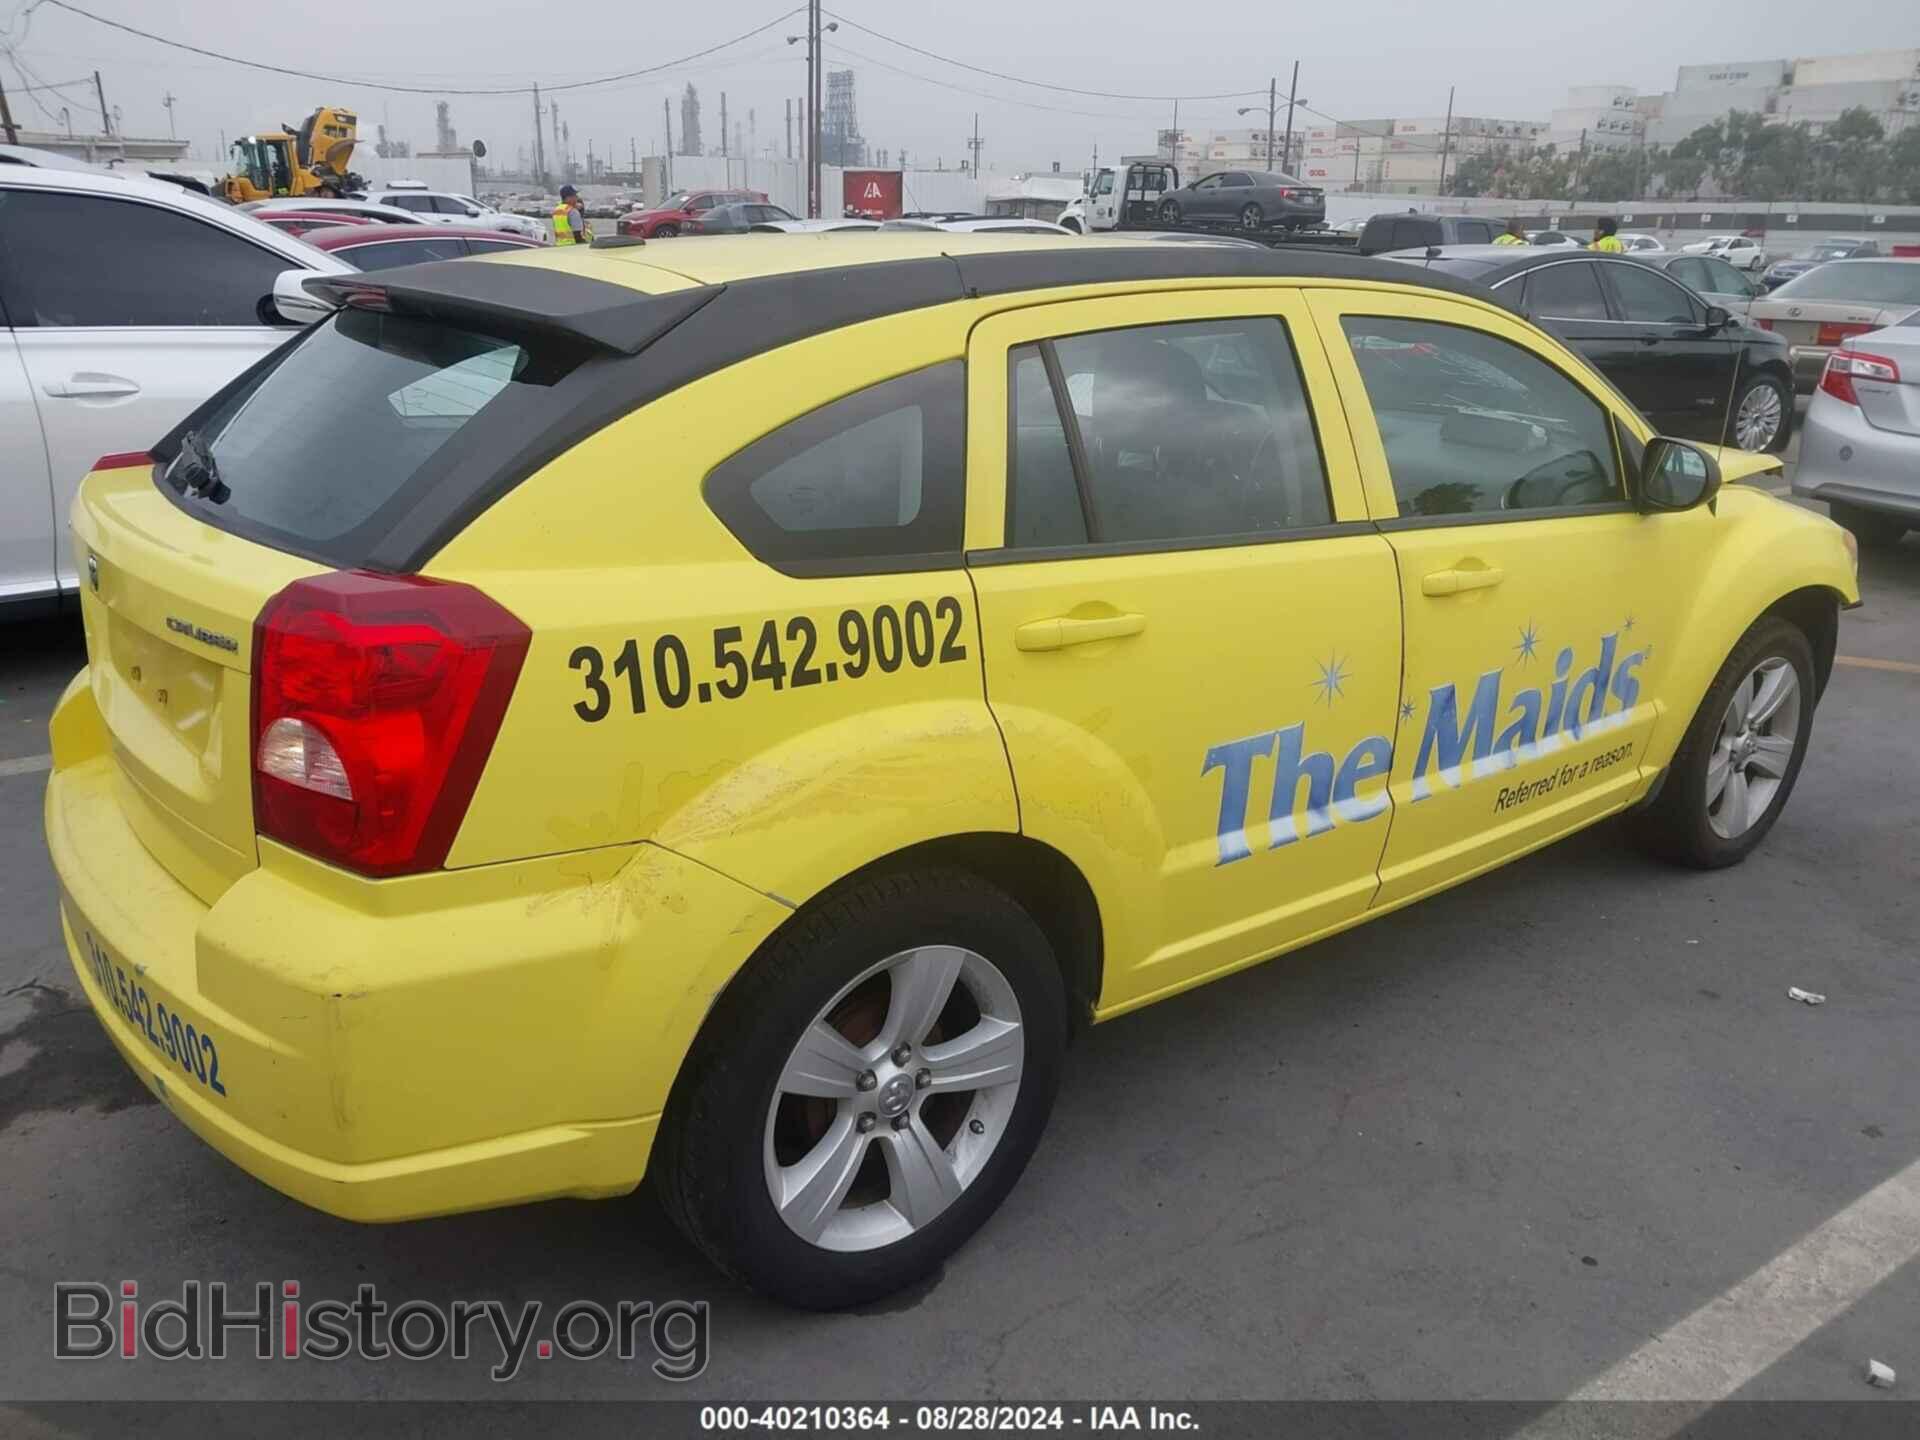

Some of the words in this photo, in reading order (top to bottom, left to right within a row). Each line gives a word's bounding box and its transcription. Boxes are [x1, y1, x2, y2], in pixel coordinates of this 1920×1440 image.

[568, 596, 968, 723] 310.542.9002
[1199, 720, 1394, 868] The
[1410, 631, 1645, 804] Maids
[1493, 767, 1559, 814] Referred
[1557, 763, 1580, 788] for
[1578, 760, 1589, 778] a
